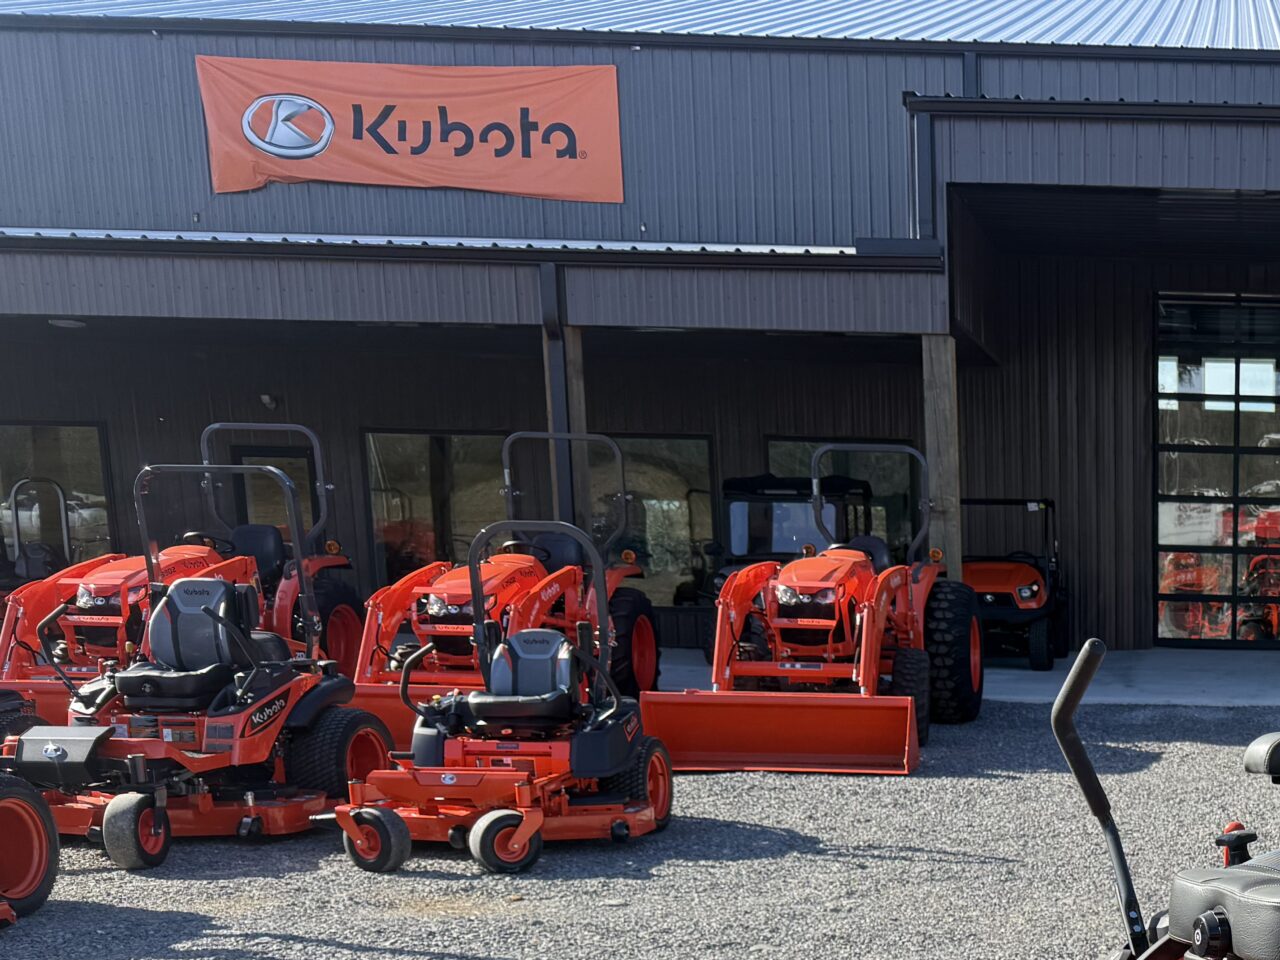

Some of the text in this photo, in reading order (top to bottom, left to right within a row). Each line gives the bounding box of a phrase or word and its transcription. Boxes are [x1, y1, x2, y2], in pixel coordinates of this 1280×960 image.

[351, 103, 578, 160] Kubota
[183, 588, 211, 596] Kubota
[251, 698, 286, 725] Kubota
